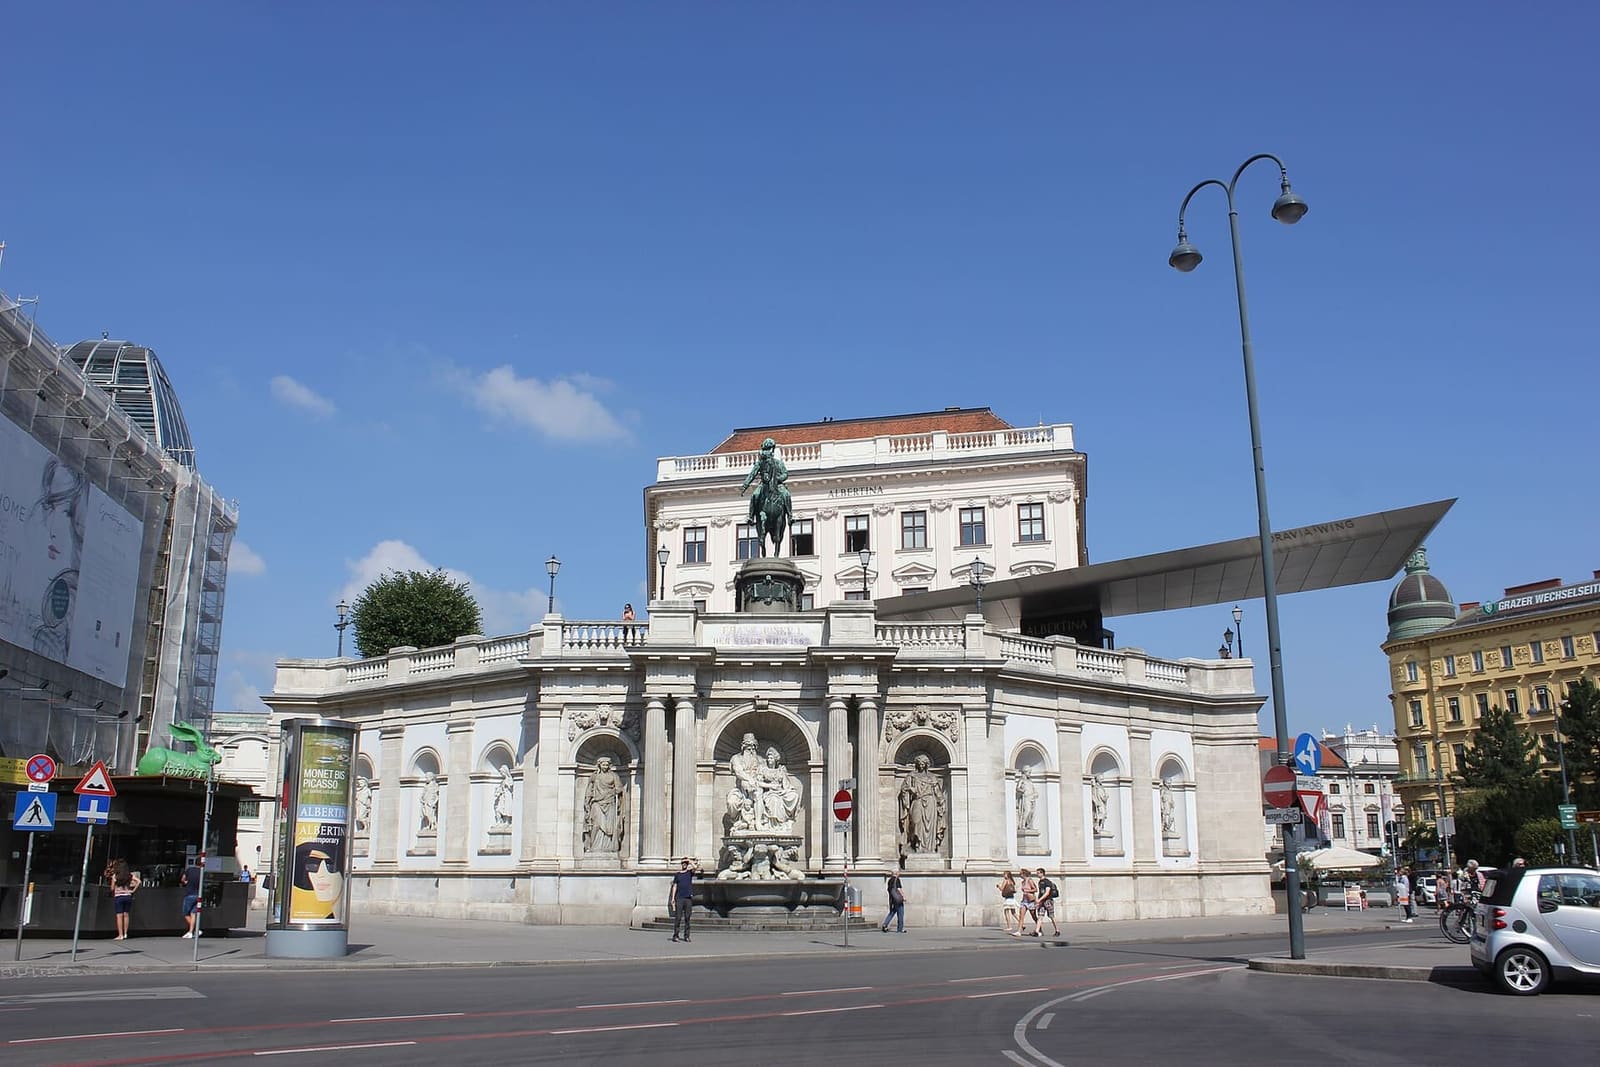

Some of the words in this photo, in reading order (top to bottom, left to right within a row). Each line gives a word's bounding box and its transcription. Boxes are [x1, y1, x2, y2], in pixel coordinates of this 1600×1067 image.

[828, 485, 884, 498] ALBERTINA
[1317, 520, 1354, 534] WING
[1498, 597, 1533, 611] GRAZER
[303, 768, 333, 779] MONET
[334, 770, 346, 780] BIS
[303, 779, 338, 790] PICASSO
